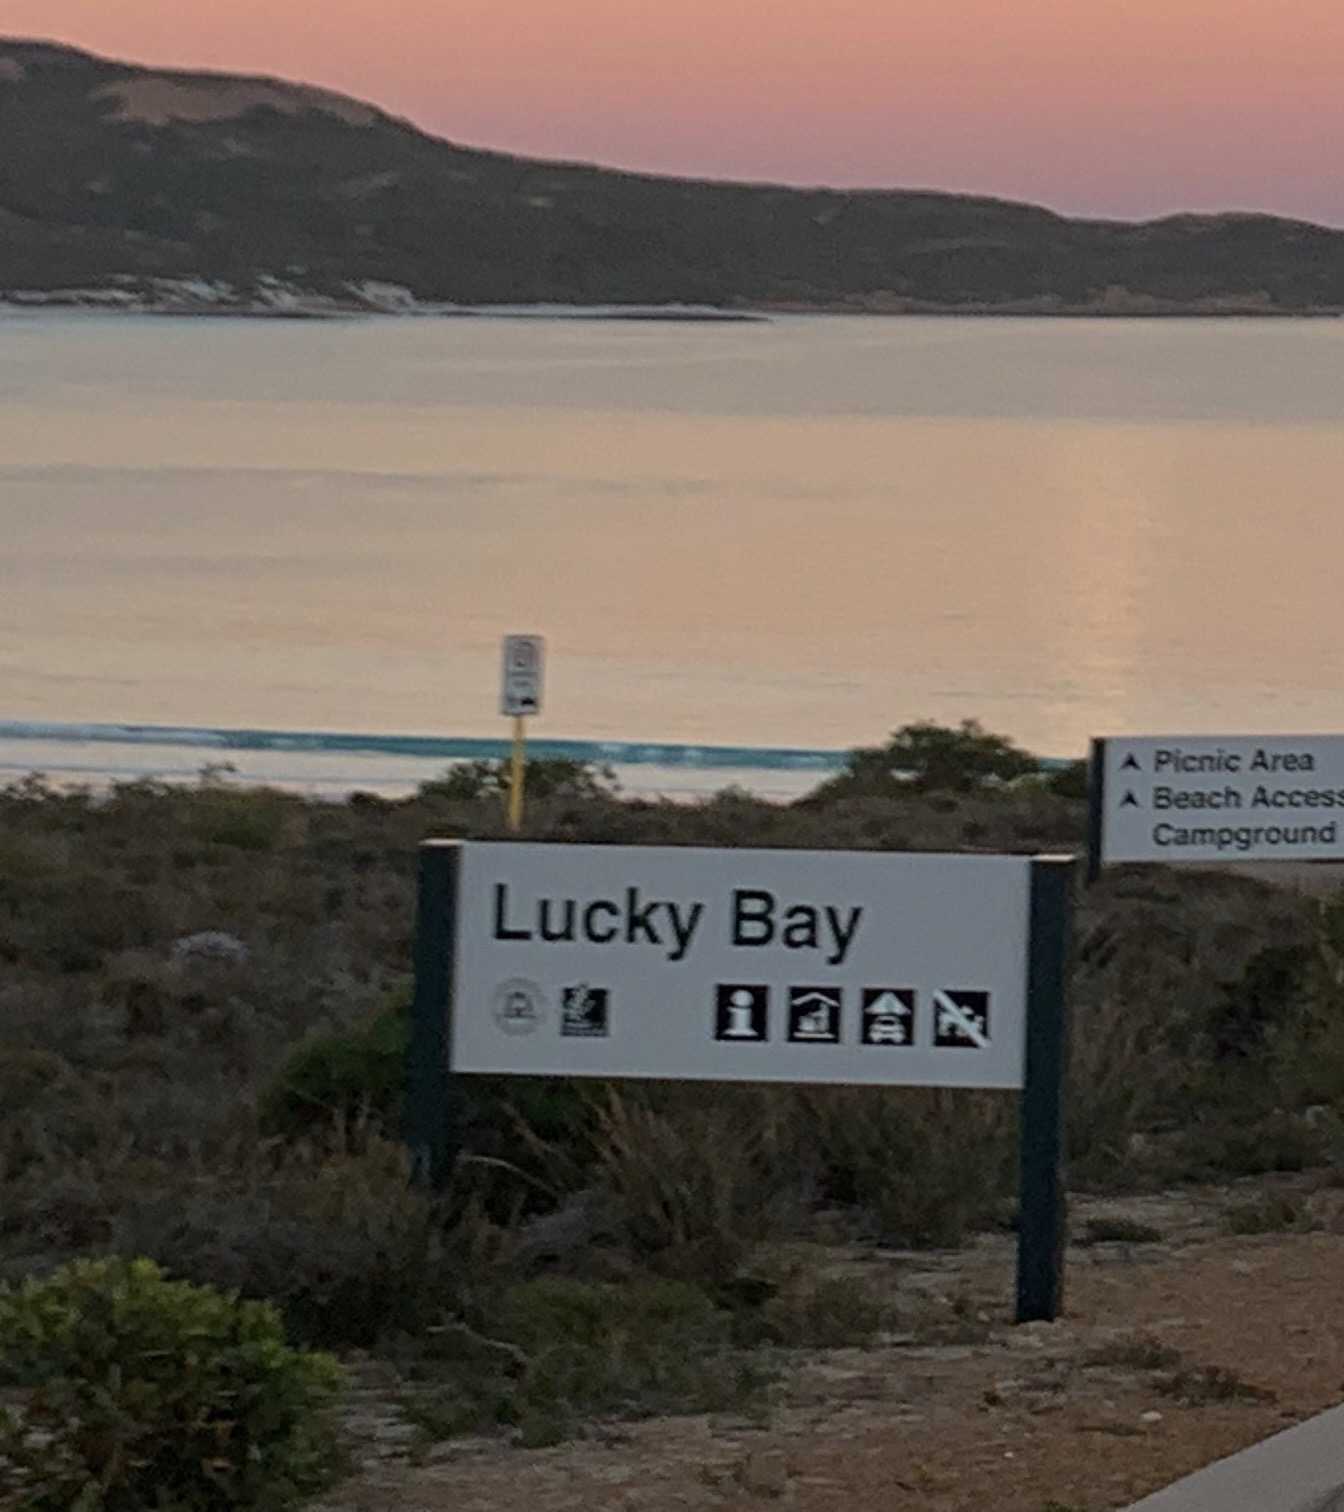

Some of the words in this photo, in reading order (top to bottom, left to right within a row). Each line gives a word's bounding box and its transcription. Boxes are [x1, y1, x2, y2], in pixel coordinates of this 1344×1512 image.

[1153, 748, 1241, 773] Picnic
[1249, 748, 1315, 772] Area
[1152, 786, 1242, 810] Beach
[1152, 820, 1337, 850] Campground
[491, 882, 704, 961] Lucky
[730, 889, 863, 965] Bay
